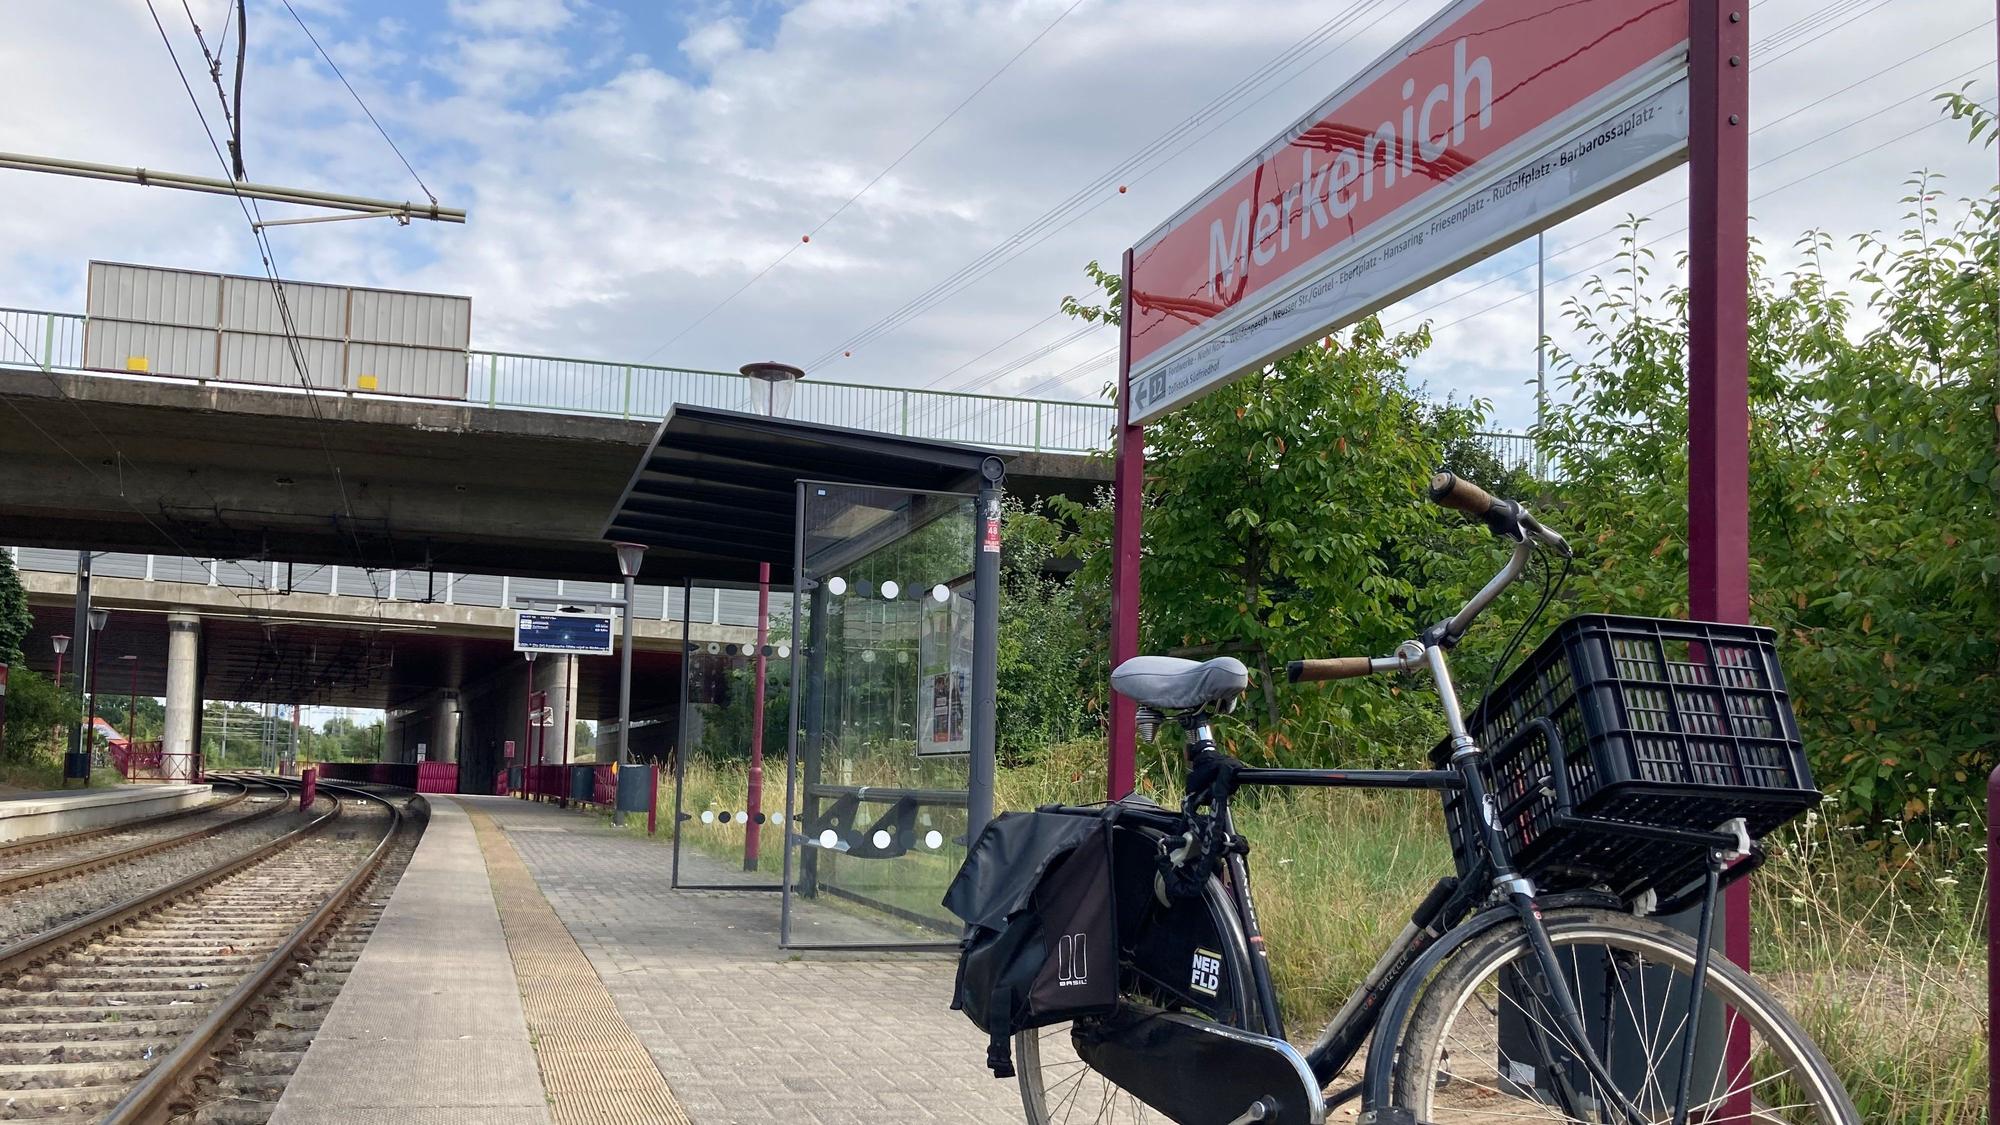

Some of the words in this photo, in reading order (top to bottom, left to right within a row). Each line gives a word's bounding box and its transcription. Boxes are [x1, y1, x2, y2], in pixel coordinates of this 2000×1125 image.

[1207, 37, 1493, 298] Merkenich
[1272, 301, 1298, 321] Neusser
[1339, 257, 1377, 284] Ebertplatz
[1383, 232, 1424, 262] Hansaring
[1430, 198, 1485, 236] Friesenplatz
[1492, 163, 1551, 203] Rudolfplatz
[1560, 108, 1655, 167] Barbarossaplatz
[1151, 376, 1165, 398] 12
[1168, 375, 1190, 396] Zollstock
[1192, 954, 1220, 975] NER
[1059, 979, 1088, 987] BASIL
[1191, 971, 1219, 991] FLD
